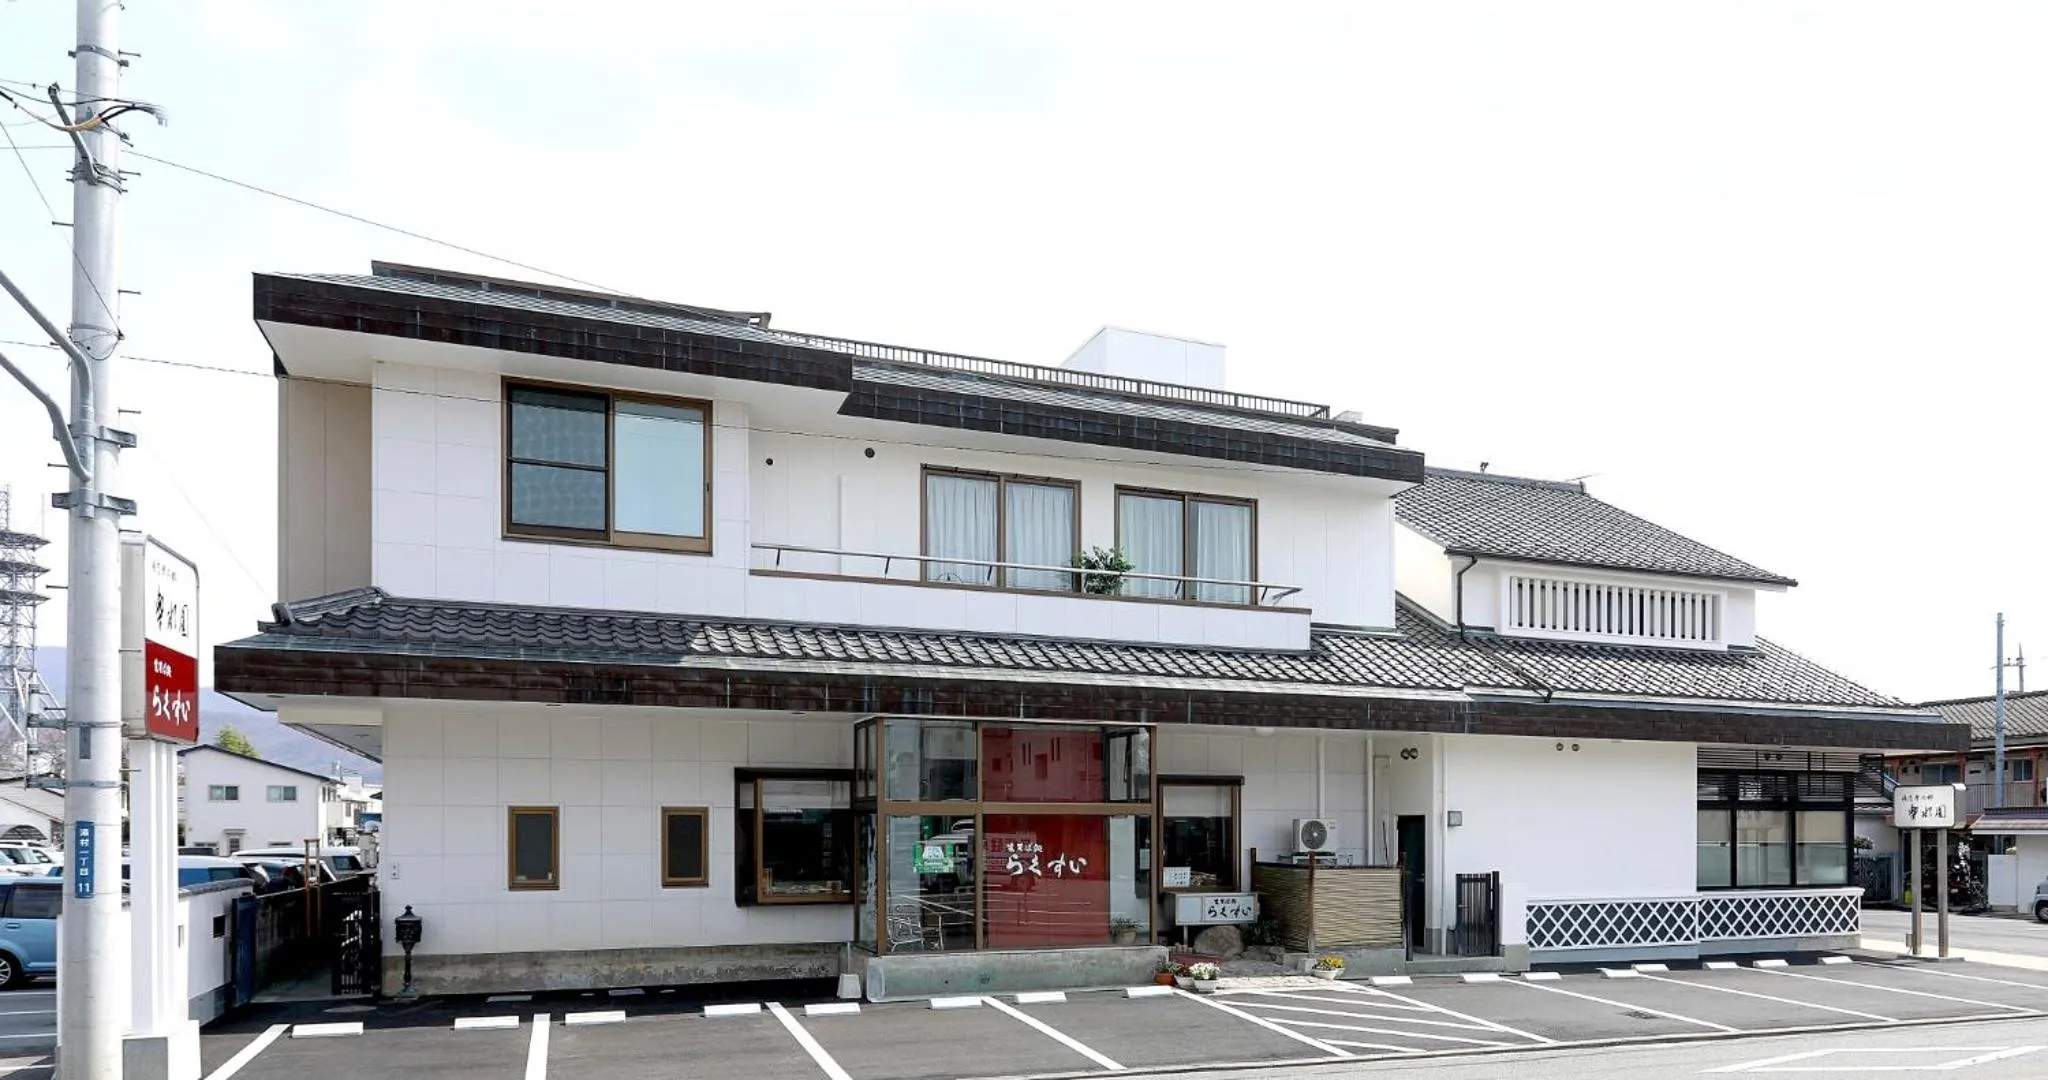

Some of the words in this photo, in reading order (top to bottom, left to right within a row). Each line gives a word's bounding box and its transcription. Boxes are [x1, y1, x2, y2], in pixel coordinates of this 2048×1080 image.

[152, 684, 191, 726] らくすい
[1006, 852, 1088, 879] らくすい
[79, 882, 90, 893] 11
[1207, 905, 1253, 918] らくすい
